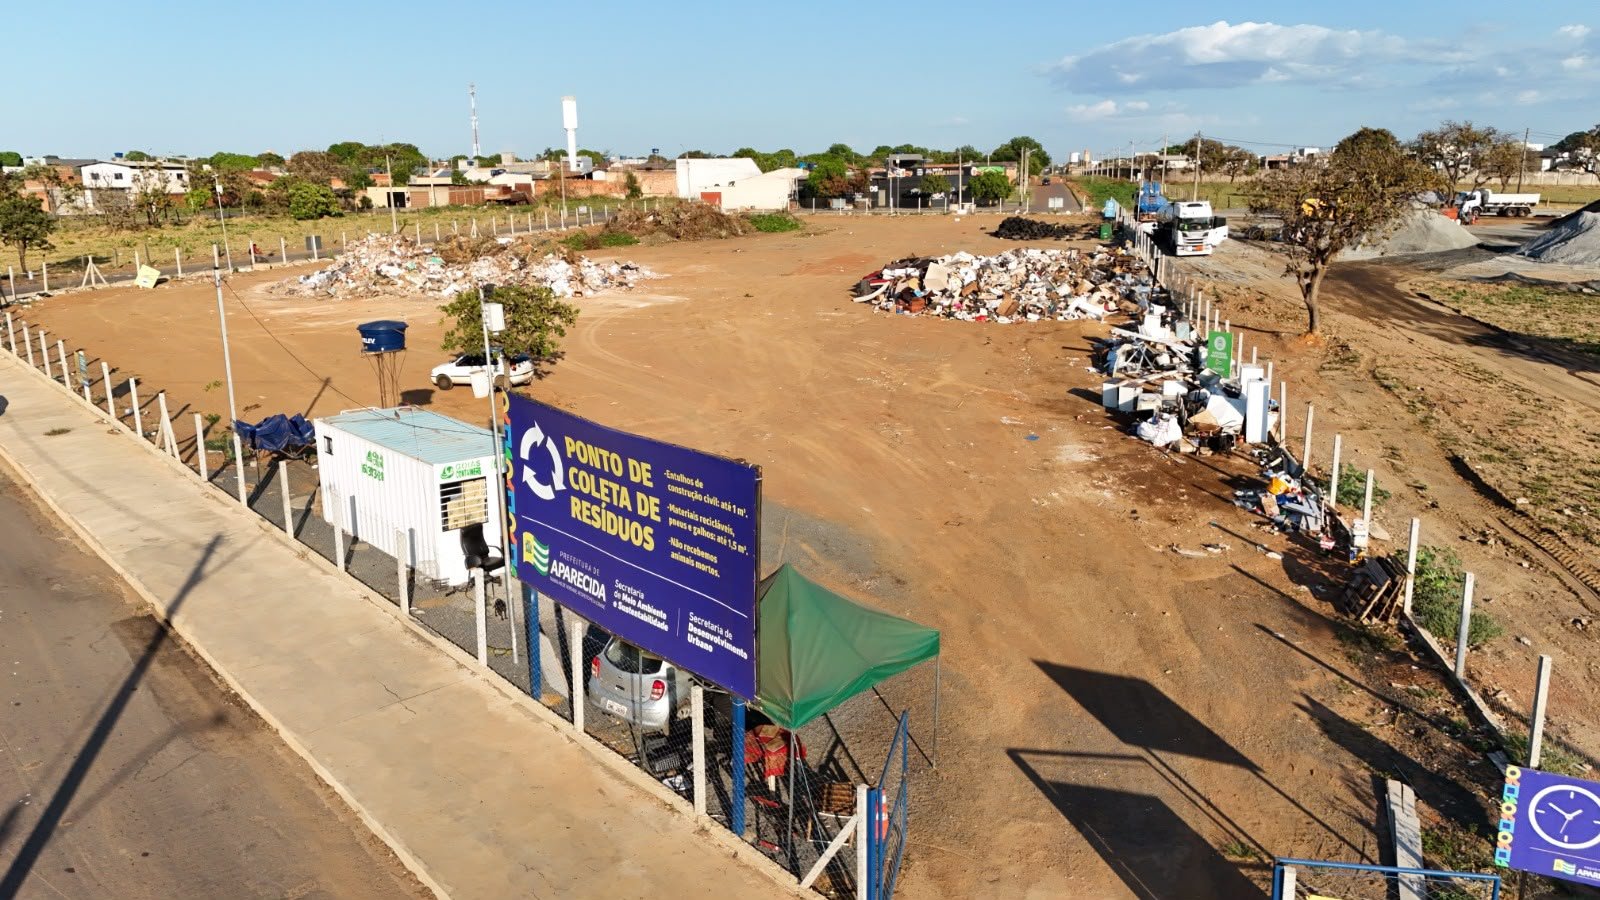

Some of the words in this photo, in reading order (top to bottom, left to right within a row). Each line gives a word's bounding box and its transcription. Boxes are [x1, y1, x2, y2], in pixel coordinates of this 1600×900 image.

[456, 467, 482, 479] CONTAINERS
[565, 436, 623, 477] PONTO
[628, 458, 654, 488] DE
[664, 470, 694, 486] -Entulhos
[695, 479, 703, 488] de
[569, 467, 632, 511] COLETA
[637, 492, 661, 522] DE
[668, 484, 702, 501] construção
[704, 494, 720, 507] civil:
[721, 501, 732, 512] até
[733, 505, 737, 514] 1
[571, 496, 655, 551] RESÍDUOS
[667, 503, 699, 521] -Materiais
[700, 515, 735, 537] recicláveis,
[669, 517, 687, 530] pneus
[688, 524, 693, 532] e
[693, 526, 716, 541] galhos:
[717, 536, 727, 546] até
[728, 539, 737, 551] 1,5
[560, 551, 592, 571] PREFEITURA
[593, 567, 600, 576] DE
[668, 537, 683, 550] -Não
[684, 546, 717, 563] recebemos
[671, 551, 694, 567] animais
[696, 562, 720, 577] mortos.
[550, 560, 606, 602] APARECIDA
[615, 579, 644, 600] Secretaria
[613, 591, 622, 600] de
[622, 594, 636, 606] Meio
[637, 600, 667, 620] Ambiente
[618, 602, 669, 632] Sustentabilidade
[689, 612, 723, 635] Secretaria
[724, 630, 733, 640] de
[687, 633, 713, 653] Urbano
[688, 622, 748, 660] Desenvolvimento
